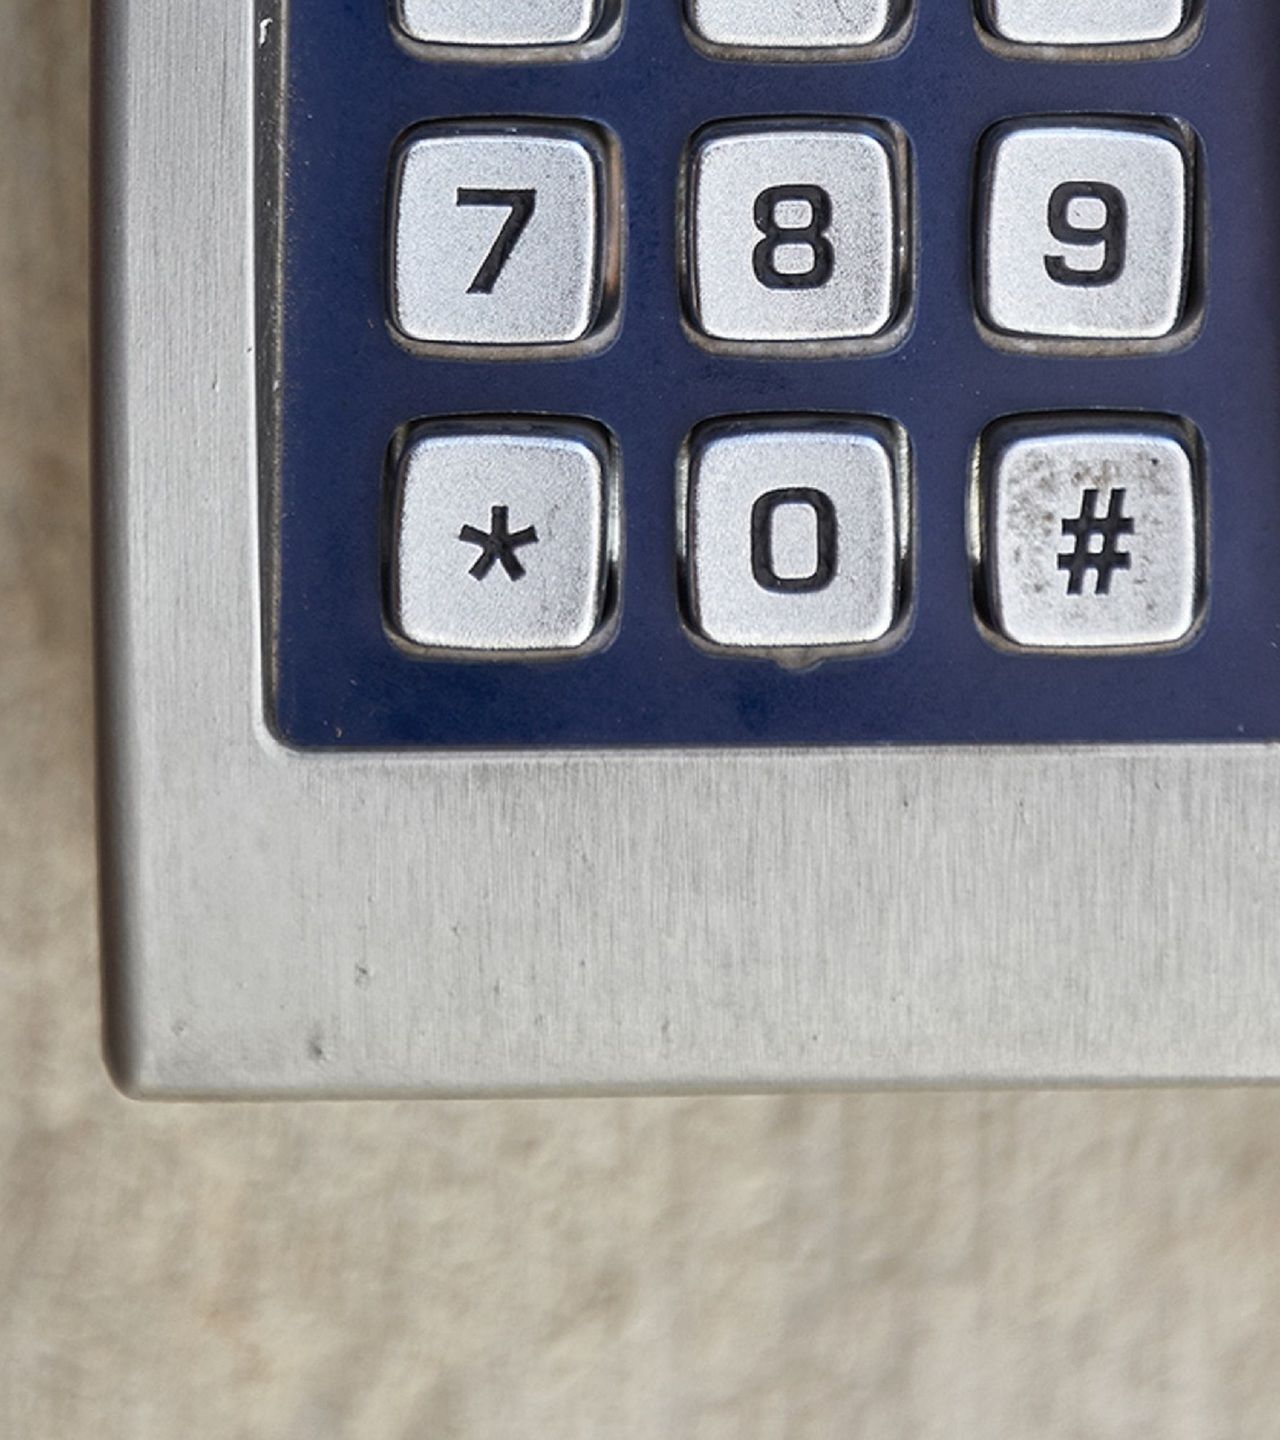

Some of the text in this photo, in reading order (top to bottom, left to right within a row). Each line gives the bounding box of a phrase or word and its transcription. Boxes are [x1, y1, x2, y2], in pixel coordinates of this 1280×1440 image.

[457, 188, 537, 294] 7
[752, 184, 834, 289] 8
[1044, 182, 1126, 287] 9
[751, 487, 838, 593] 0
[1058, 488, 1134, 594] #
